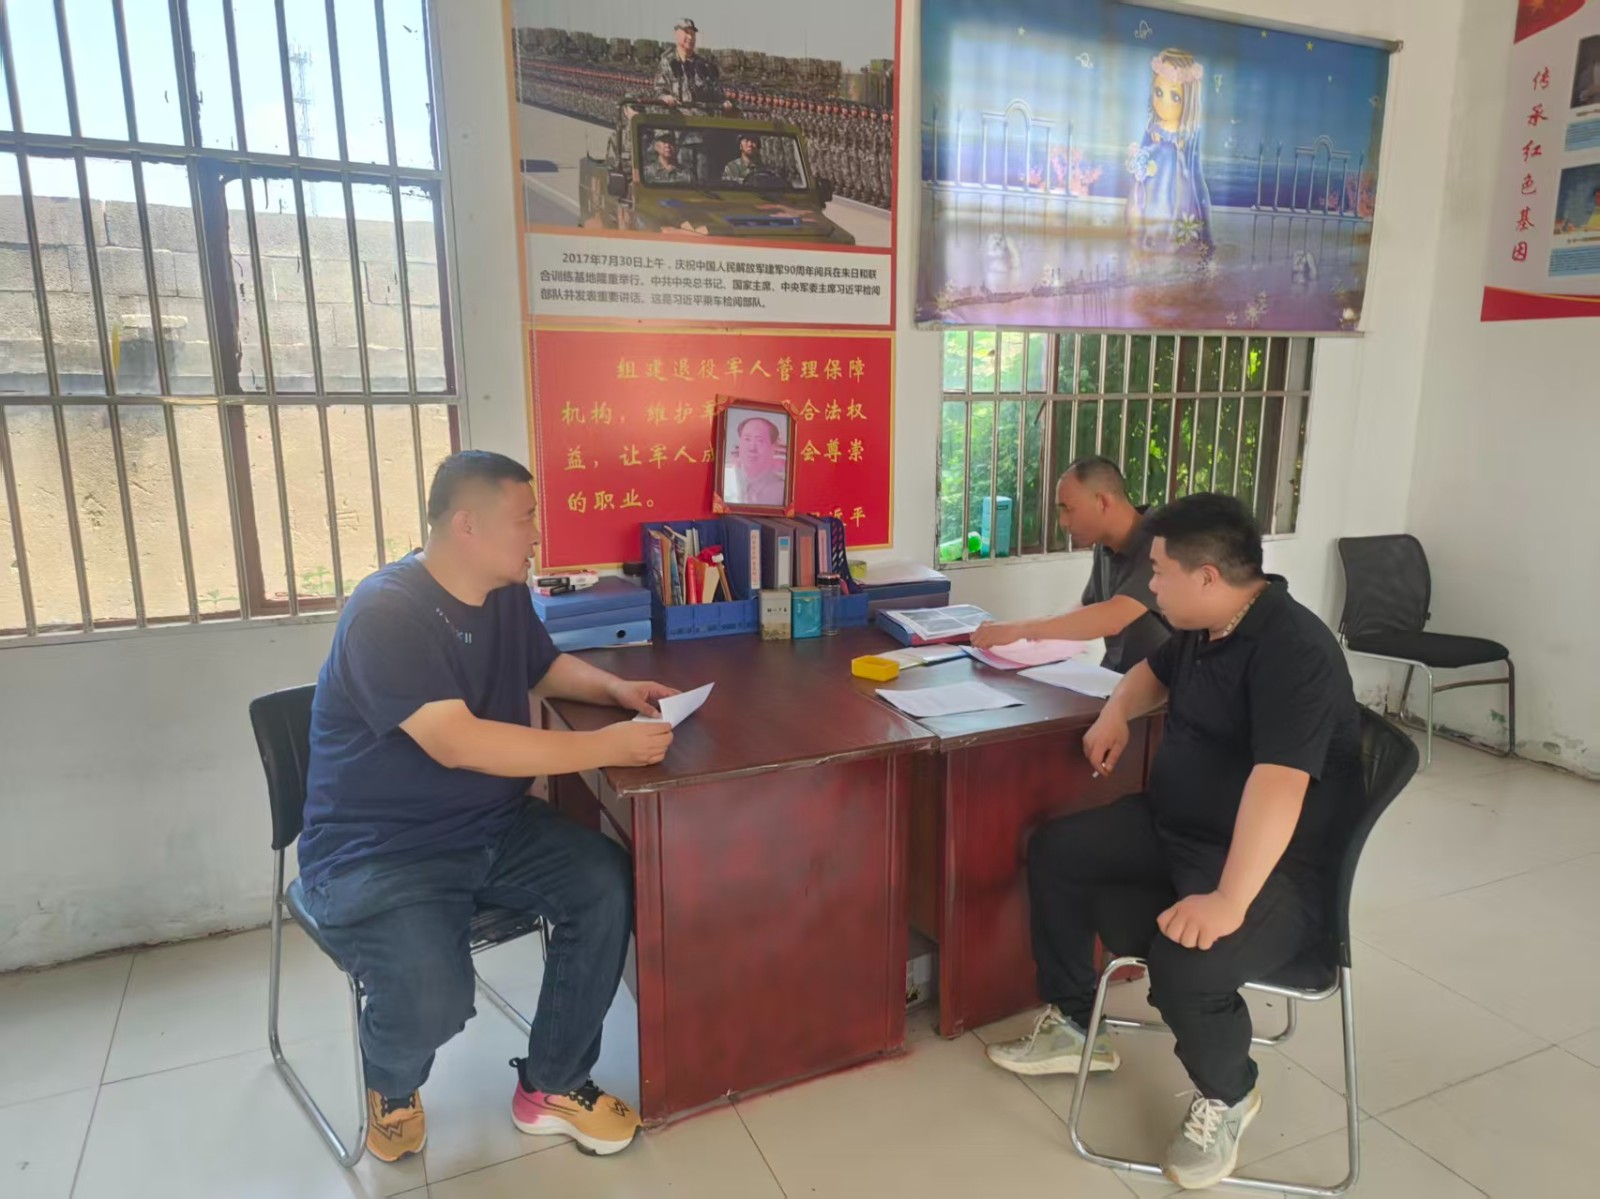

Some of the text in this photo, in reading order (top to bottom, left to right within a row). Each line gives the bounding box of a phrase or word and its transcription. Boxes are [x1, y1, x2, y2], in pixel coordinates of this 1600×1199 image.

[1511, 67, 1551, 262] 传承红色基因
[616, 356, 866, 382] 组建退役军人管理保障
[567, 489, 655, 514] 的职业。
